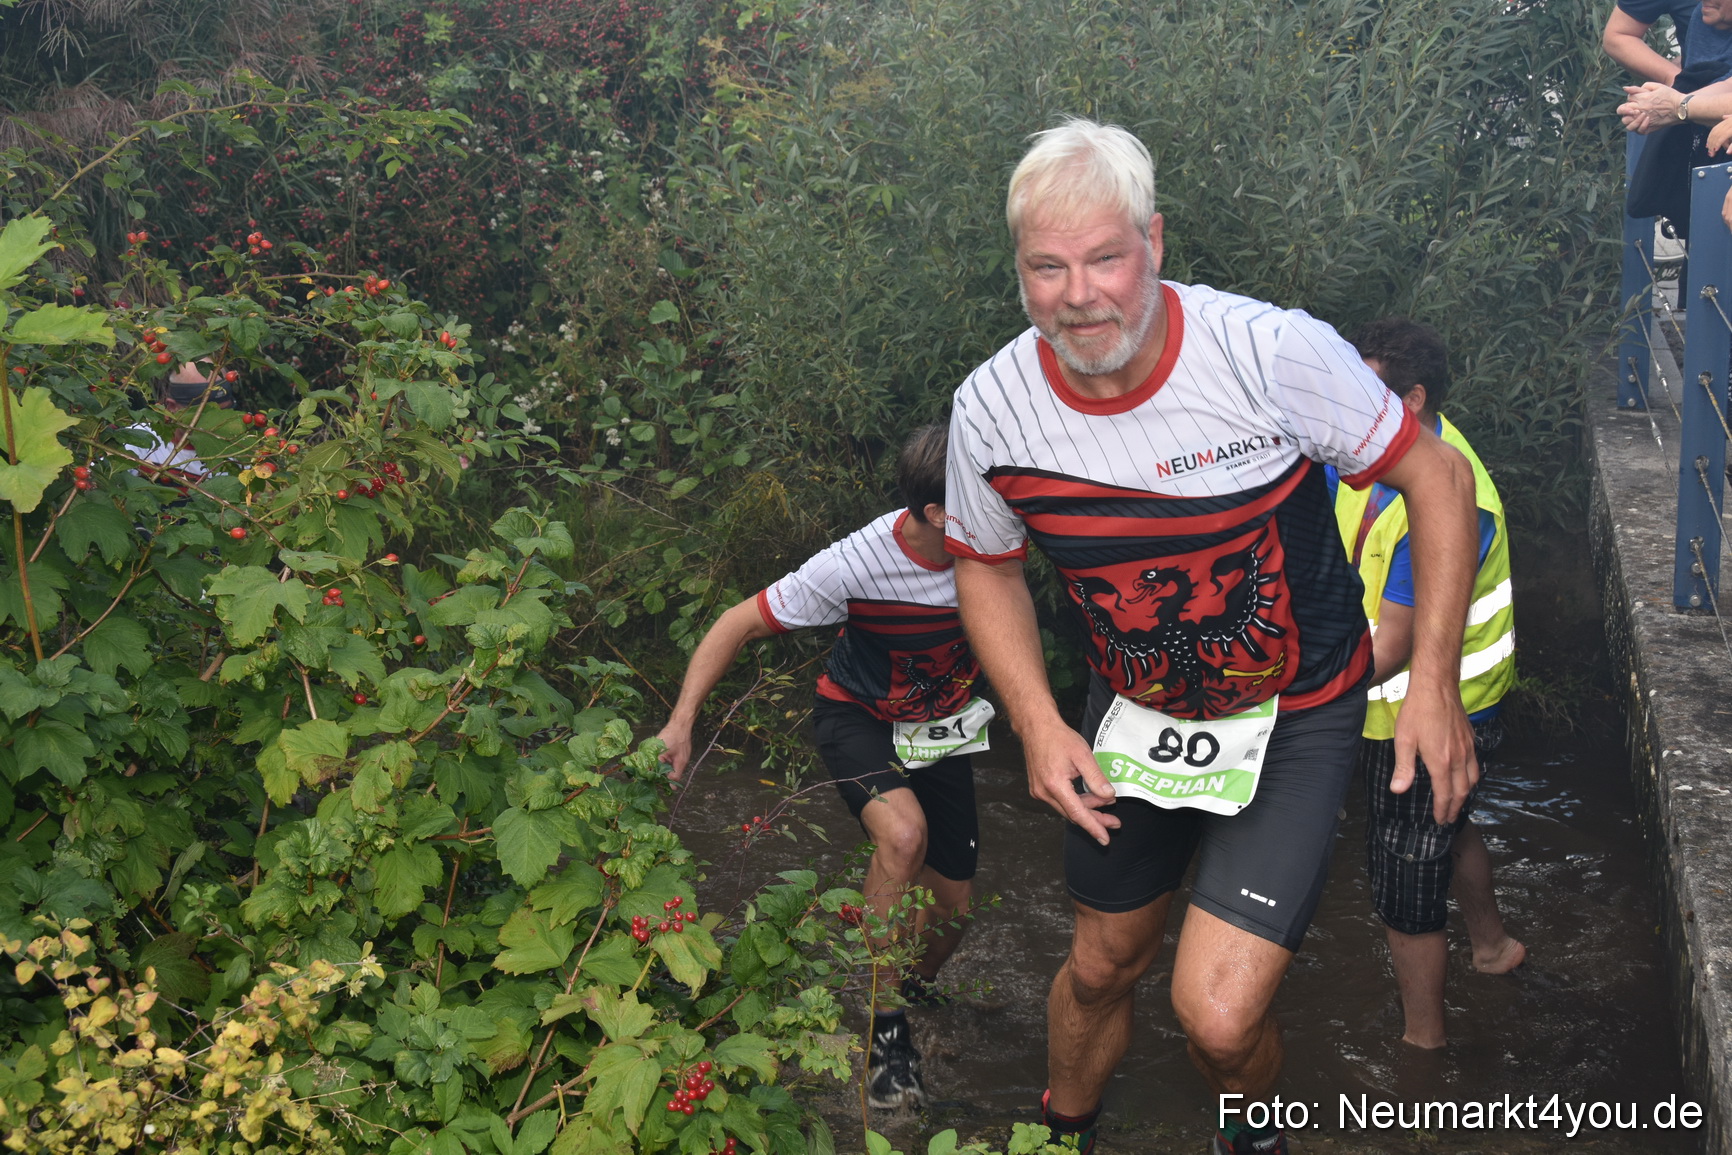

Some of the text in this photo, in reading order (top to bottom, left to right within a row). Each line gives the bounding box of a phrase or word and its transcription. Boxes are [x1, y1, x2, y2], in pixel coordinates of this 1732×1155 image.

[1156, 435, 1266, 478] NEUMARKT
[928, 717, 967, 741] 81
[1148, 727, 1221, 768] 80
[1109, 758, 1226, 795] STEPHAN
